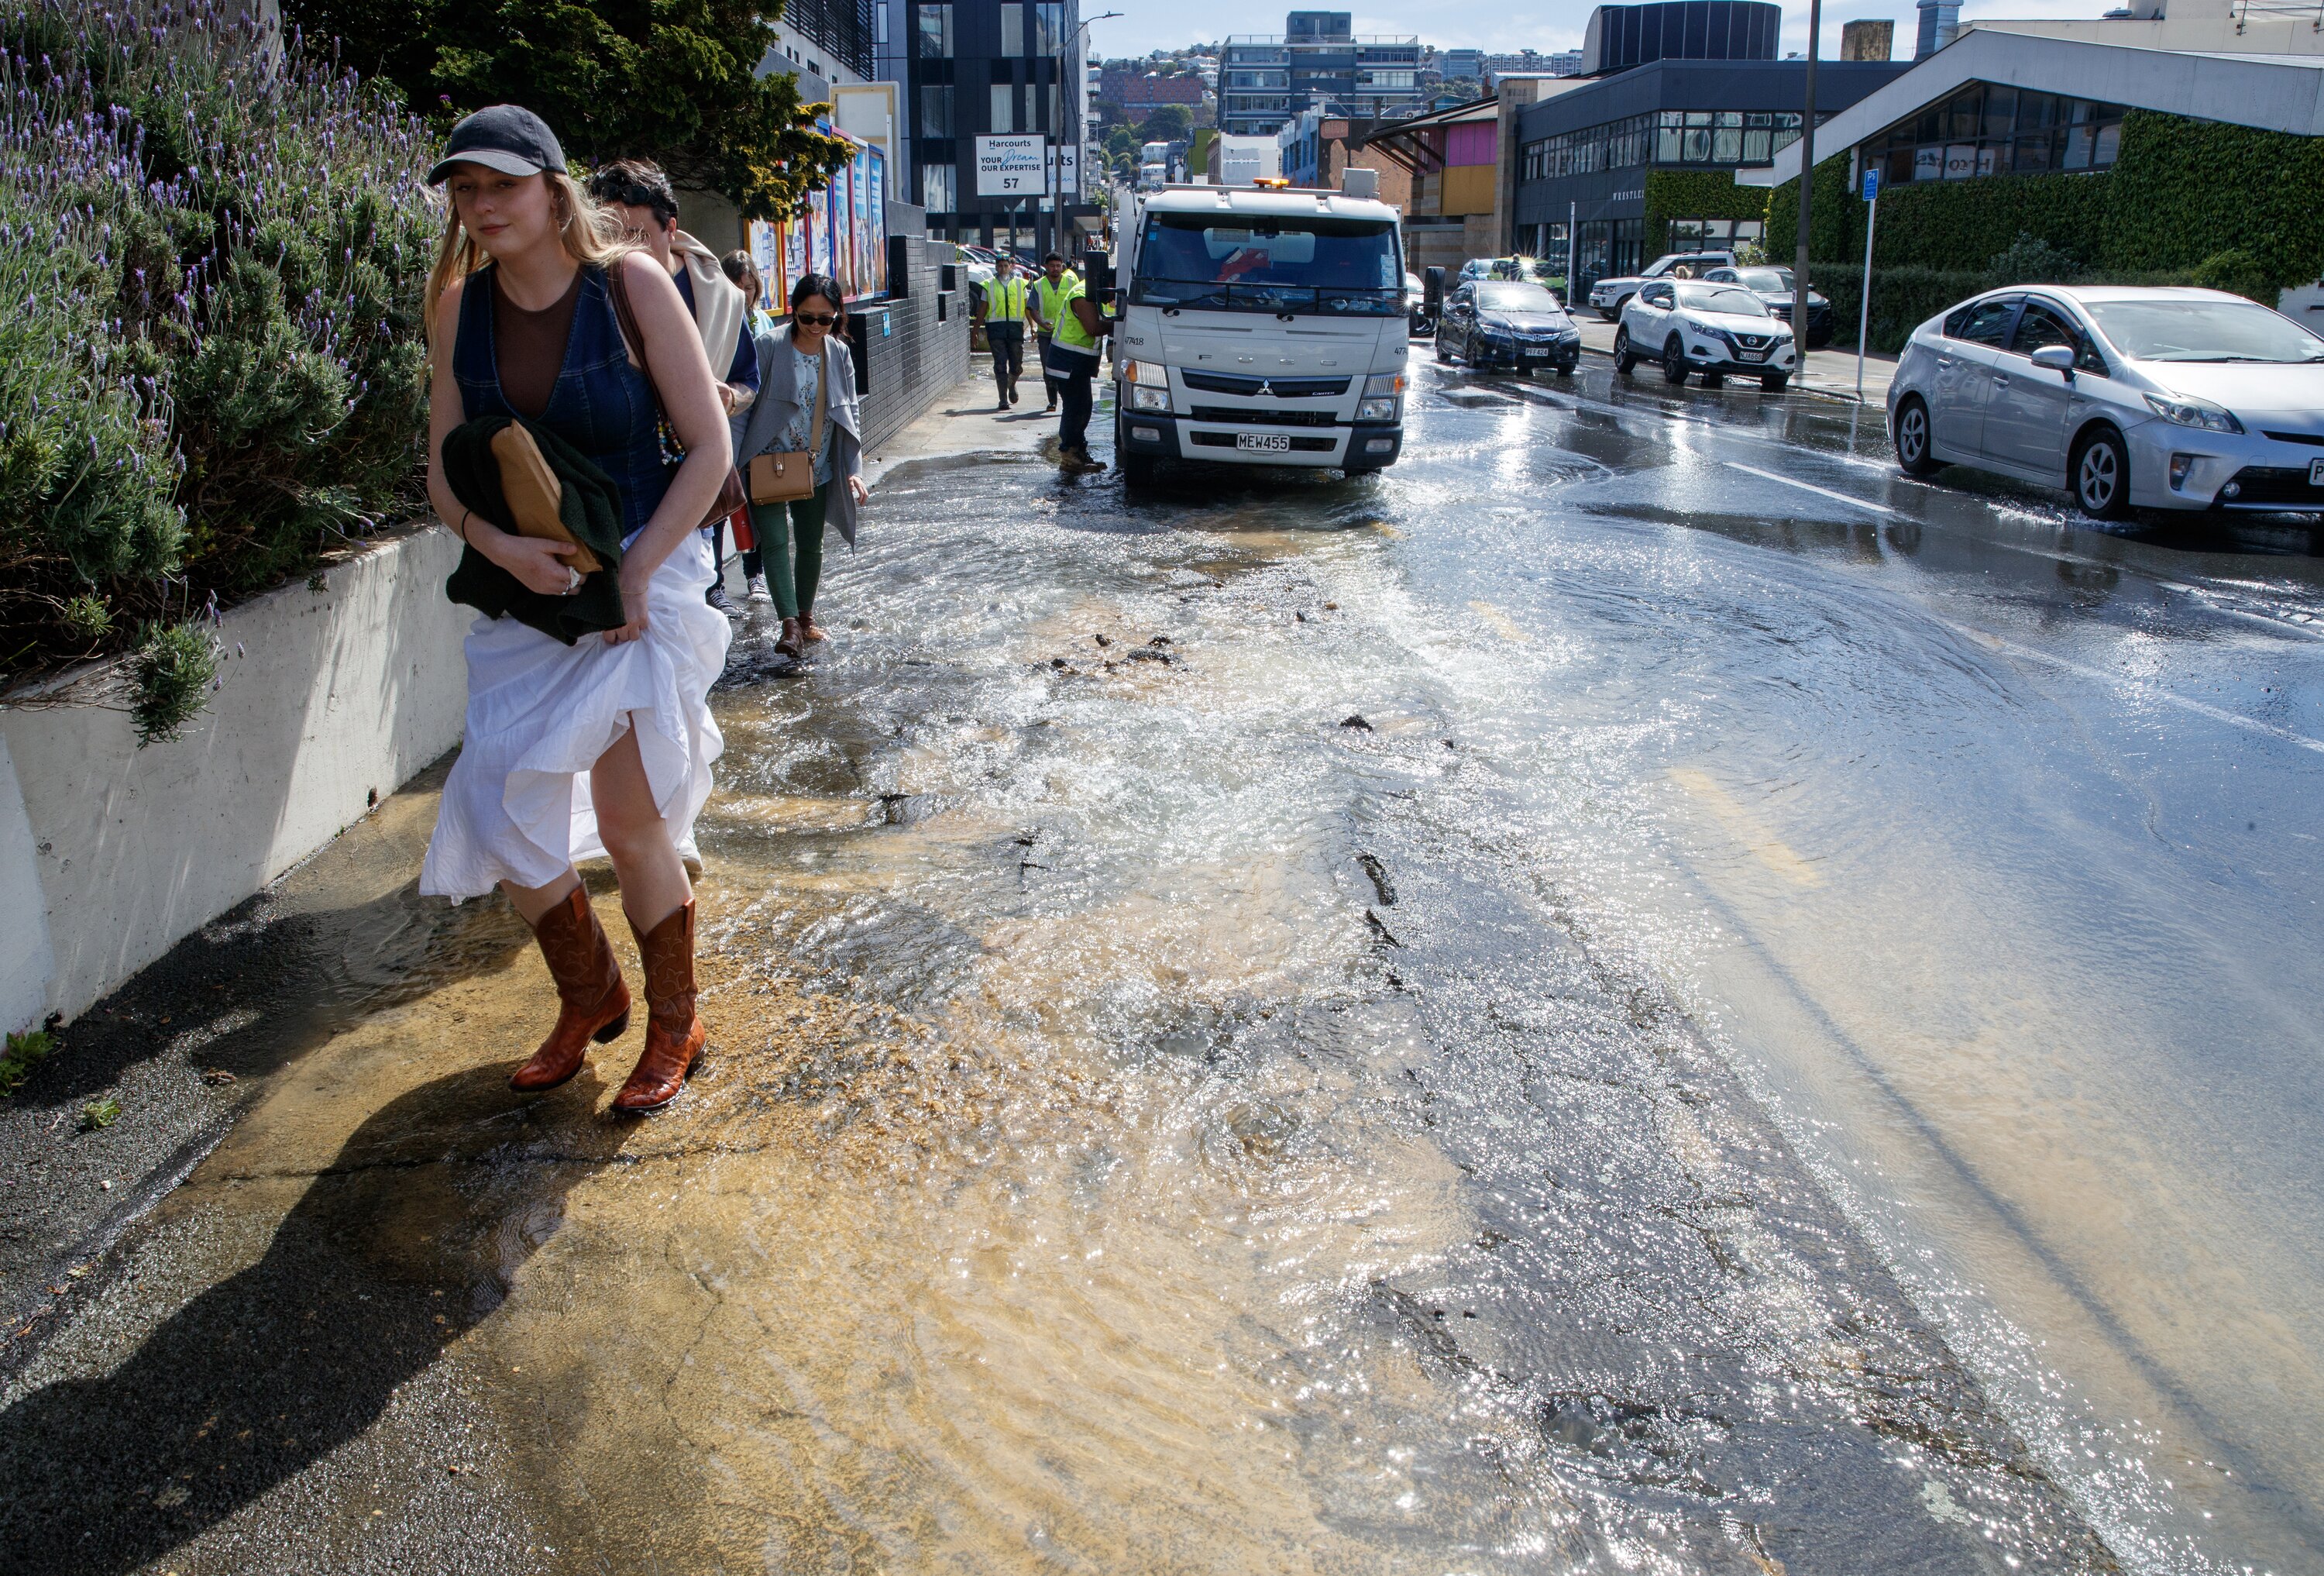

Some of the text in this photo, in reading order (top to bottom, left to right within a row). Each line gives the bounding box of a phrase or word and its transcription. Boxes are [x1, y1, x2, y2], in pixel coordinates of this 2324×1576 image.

[1002, 149, 1040, 166] Dream
[1003, 178, 1019, 188] 57
[1198, 354, 1337, 366] FUSO
[1239, 436, 1288, 450] MEW455
